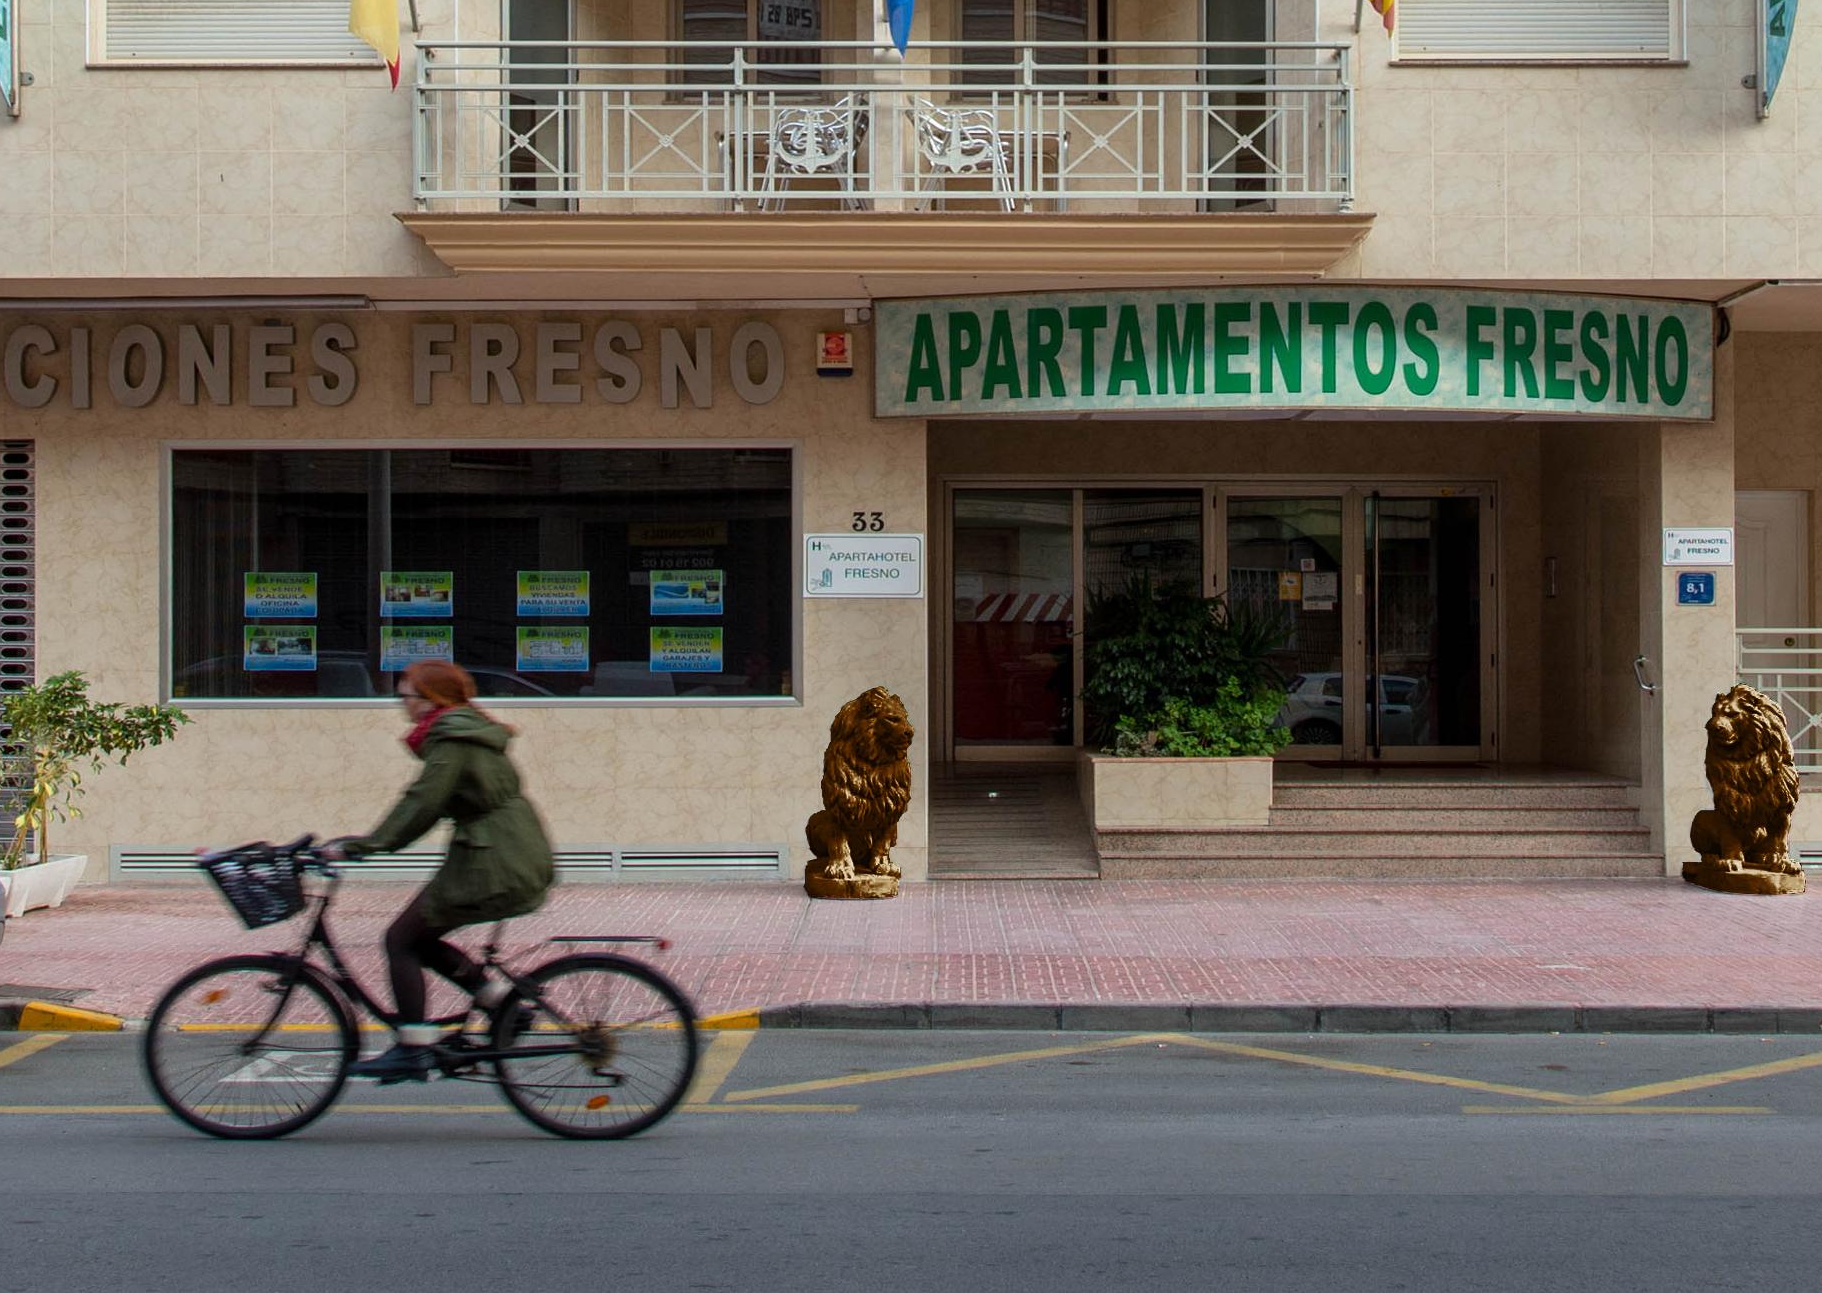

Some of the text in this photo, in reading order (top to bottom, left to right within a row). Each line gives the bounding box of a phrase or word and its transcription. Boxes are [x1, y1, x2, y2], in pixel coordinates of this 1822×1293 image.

[905, 300, 1690, 407] APARTAMENTOS FRESNO
[412, 320, 785, 409] FRESNO
[852, 511, 885, 532] 33
[812, 542, 822, 551] H
[829, 552, 916, 562] APARTAHOTEL
[844, 568, 900, 579] FRESNO
[1686, 582, 1705, 594] 8,1
